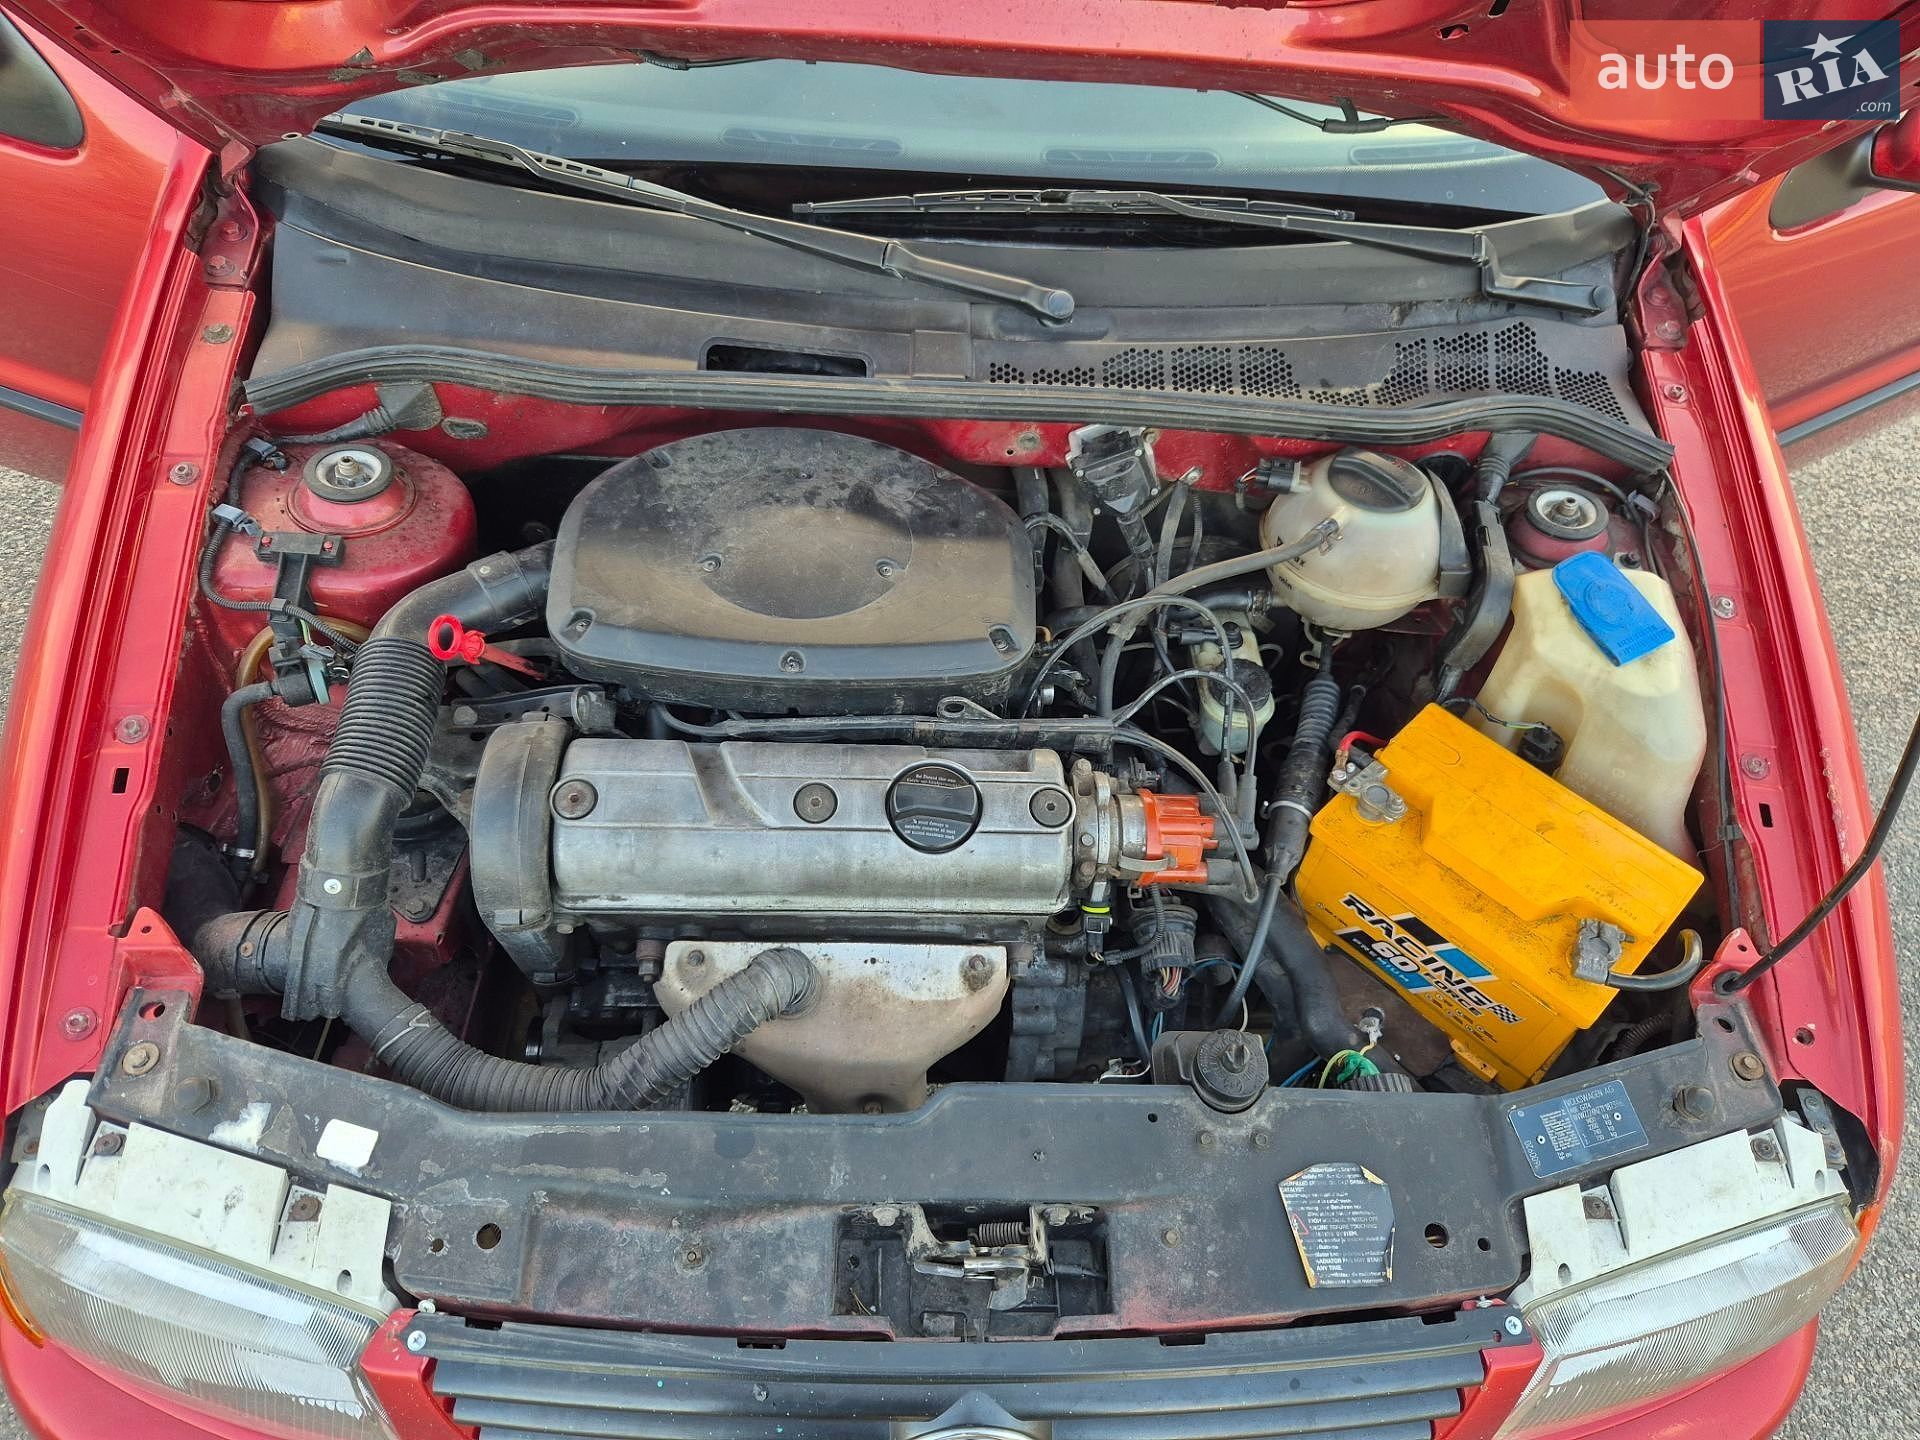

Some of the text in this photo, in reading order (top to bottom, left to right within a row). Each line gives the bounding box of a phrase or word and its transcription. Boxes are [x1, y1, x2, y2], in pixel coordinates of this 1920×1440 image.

[1341, 892, 1493, 1008] RACING
[1352, 938, 1409, 982] PREMIUM
[1371, 941, 1419, 973] 60
[1423, 973, 1482, 1016] FORCE
